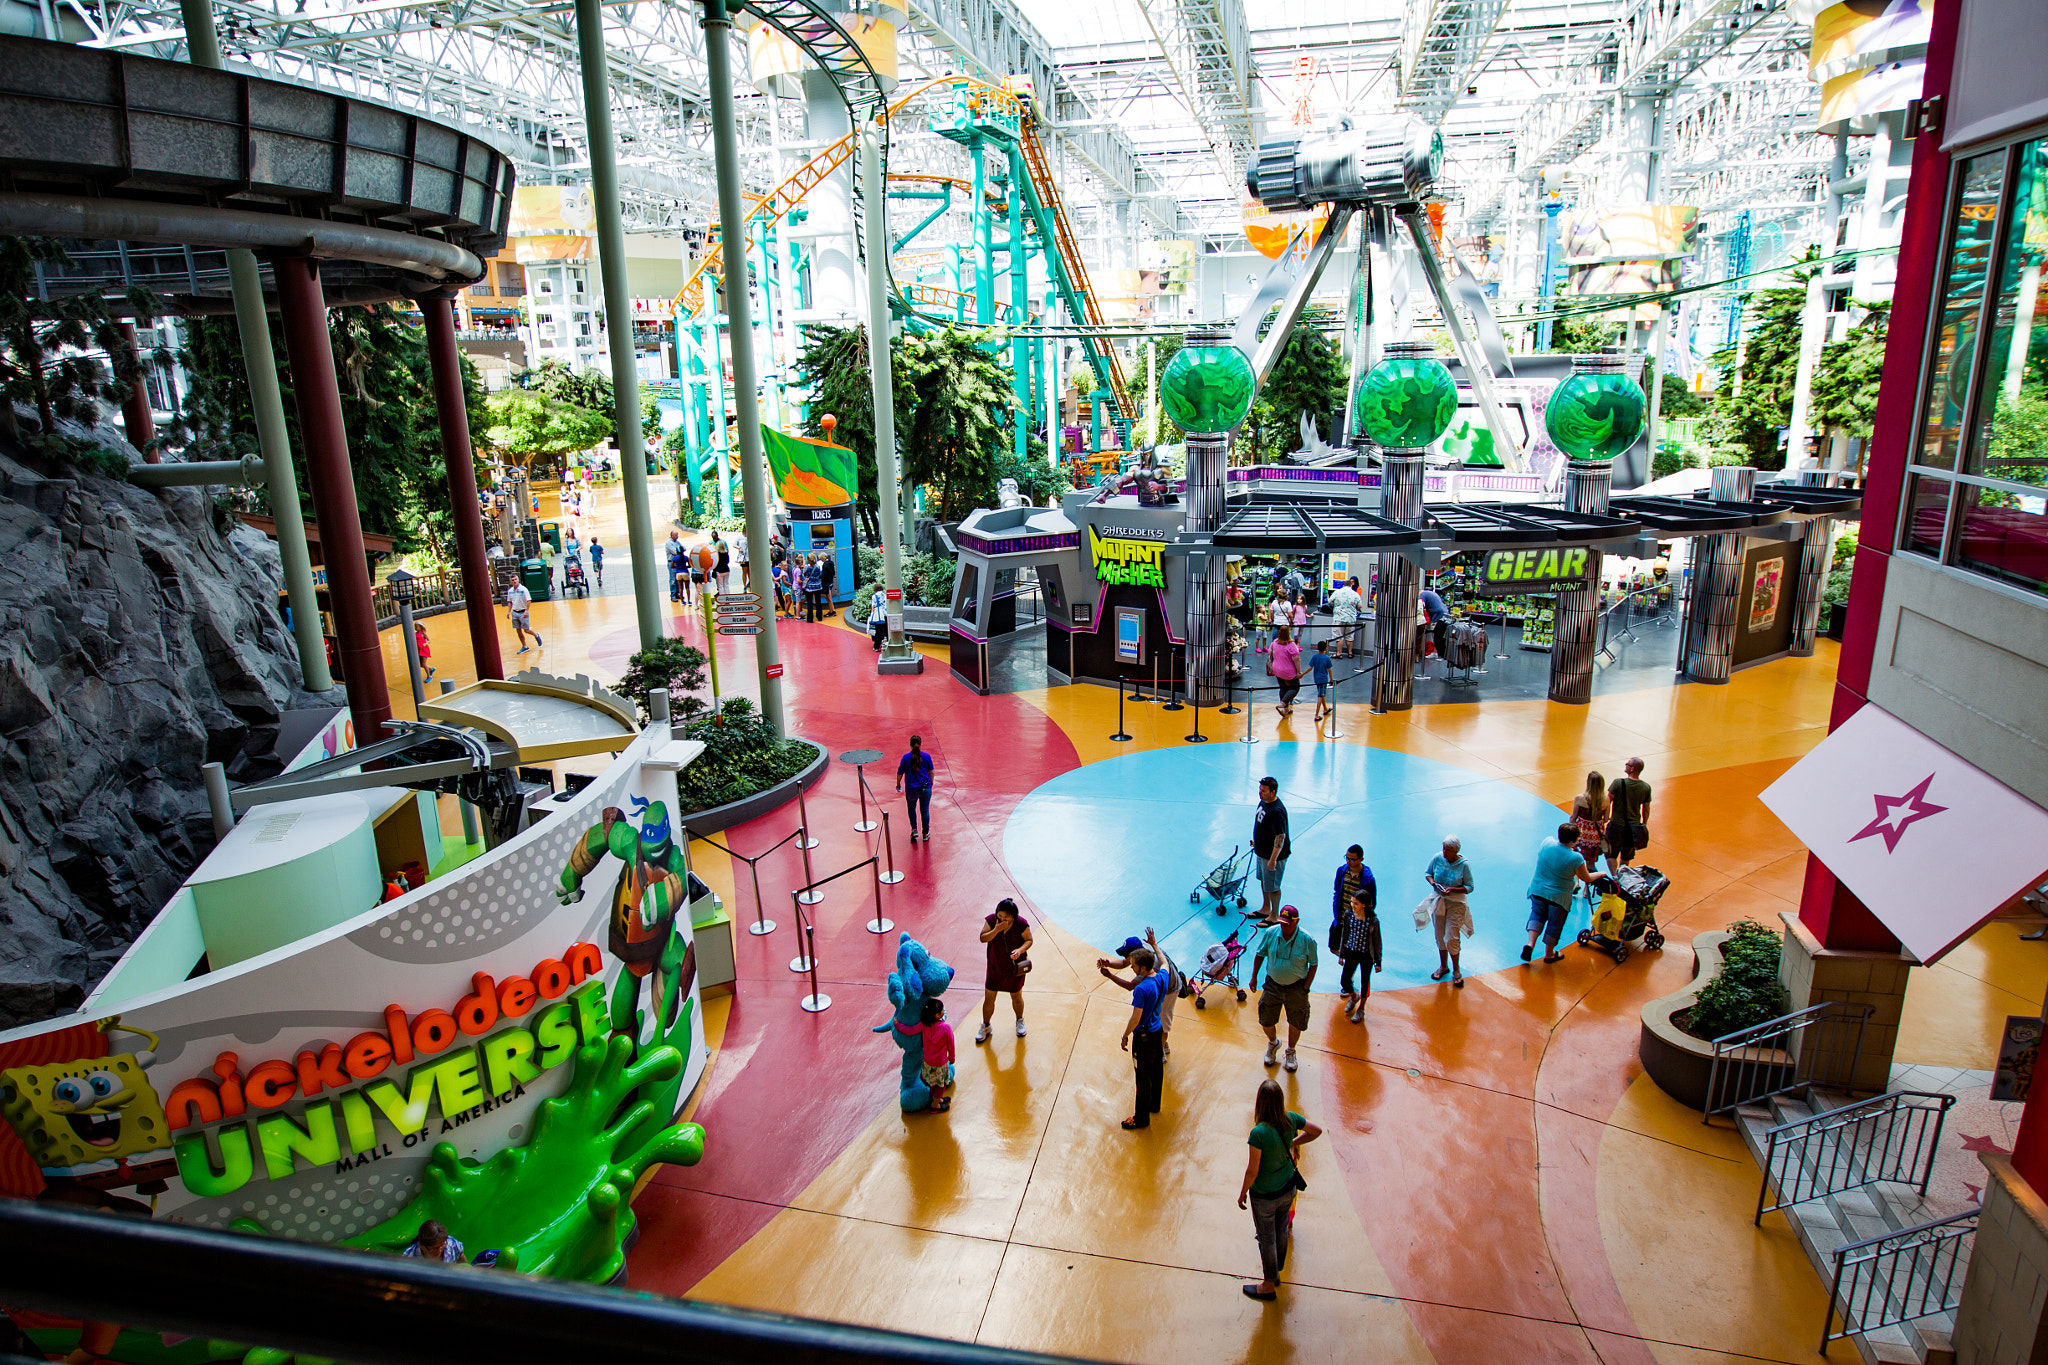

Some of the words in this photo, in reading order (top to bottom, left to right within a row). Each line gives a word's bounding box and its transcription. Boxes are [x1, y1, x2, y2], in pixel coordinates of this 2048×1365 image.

[811, 509, 831, 519] TICKETS
[1103, 525, 1164, 538] SHREDDER'S
[1088, 529, 1165, 572] MUTANT
[1487, 548, 1588, 580] GEAR
[1097, 559, 1165, 588] MASHER
[1549, 581, 1582, 592] MUTANT
[165, 941, 603, 1131] nickelodeon
[174, 980, 611, 1198] UNIVERSE
[335, 1142, 393, 1175] MALL
[402, 1128, 431, 1150] OF
[440, 1084, 526, 1135] AMERICA
